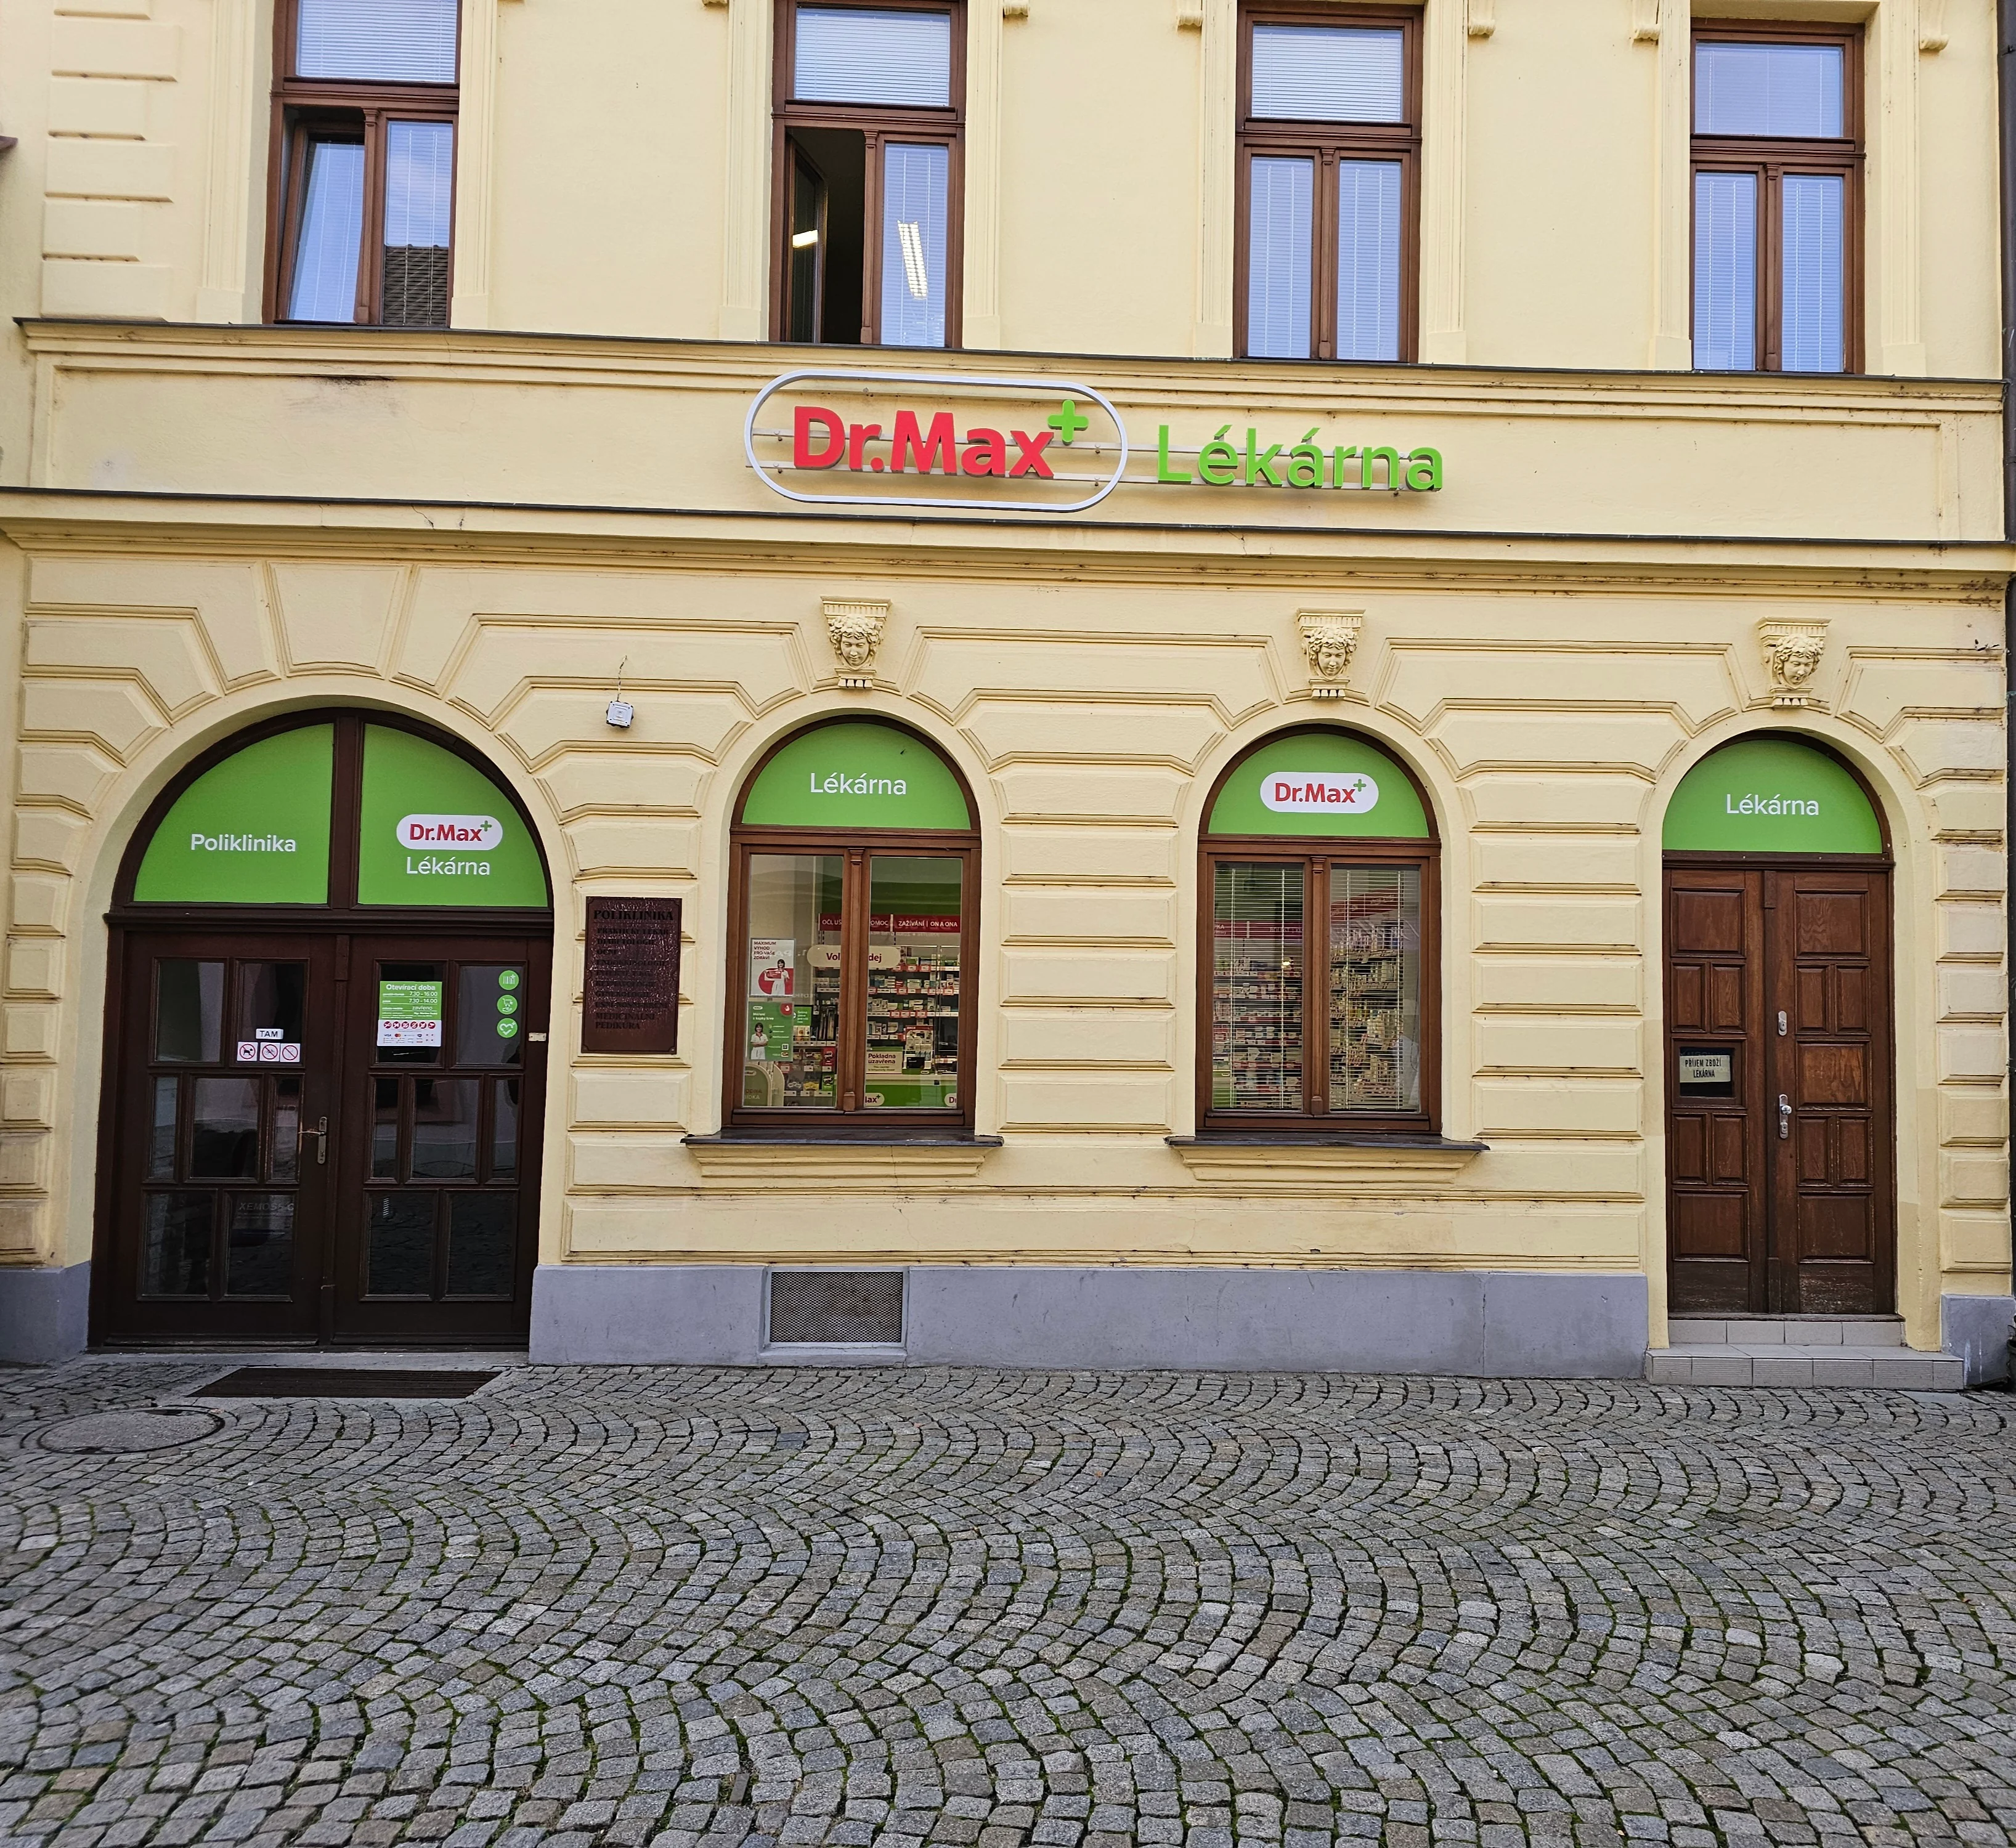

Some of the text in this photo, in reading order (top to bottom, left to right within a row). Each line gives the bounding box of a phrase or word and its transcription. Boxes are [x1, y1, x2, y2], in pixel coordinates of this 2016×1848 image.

[1156, 425, 1444, 493] Lékárna
[810, 772, 908, 795] Lékárna
[1725, 793, 1820, 816] Lékárna
[190, 833, 297, 853] Poliklinika
[406, 856, 490, 877] Lékárna
[593, 909, 674, 921] POLIKLINIKA
[826, 952, 840, 961] Vol
[259, 1030, 278, 1038] TAM
[1685, 1057, 1721, 1068] PŘÍJEM ZBOŽÍ
